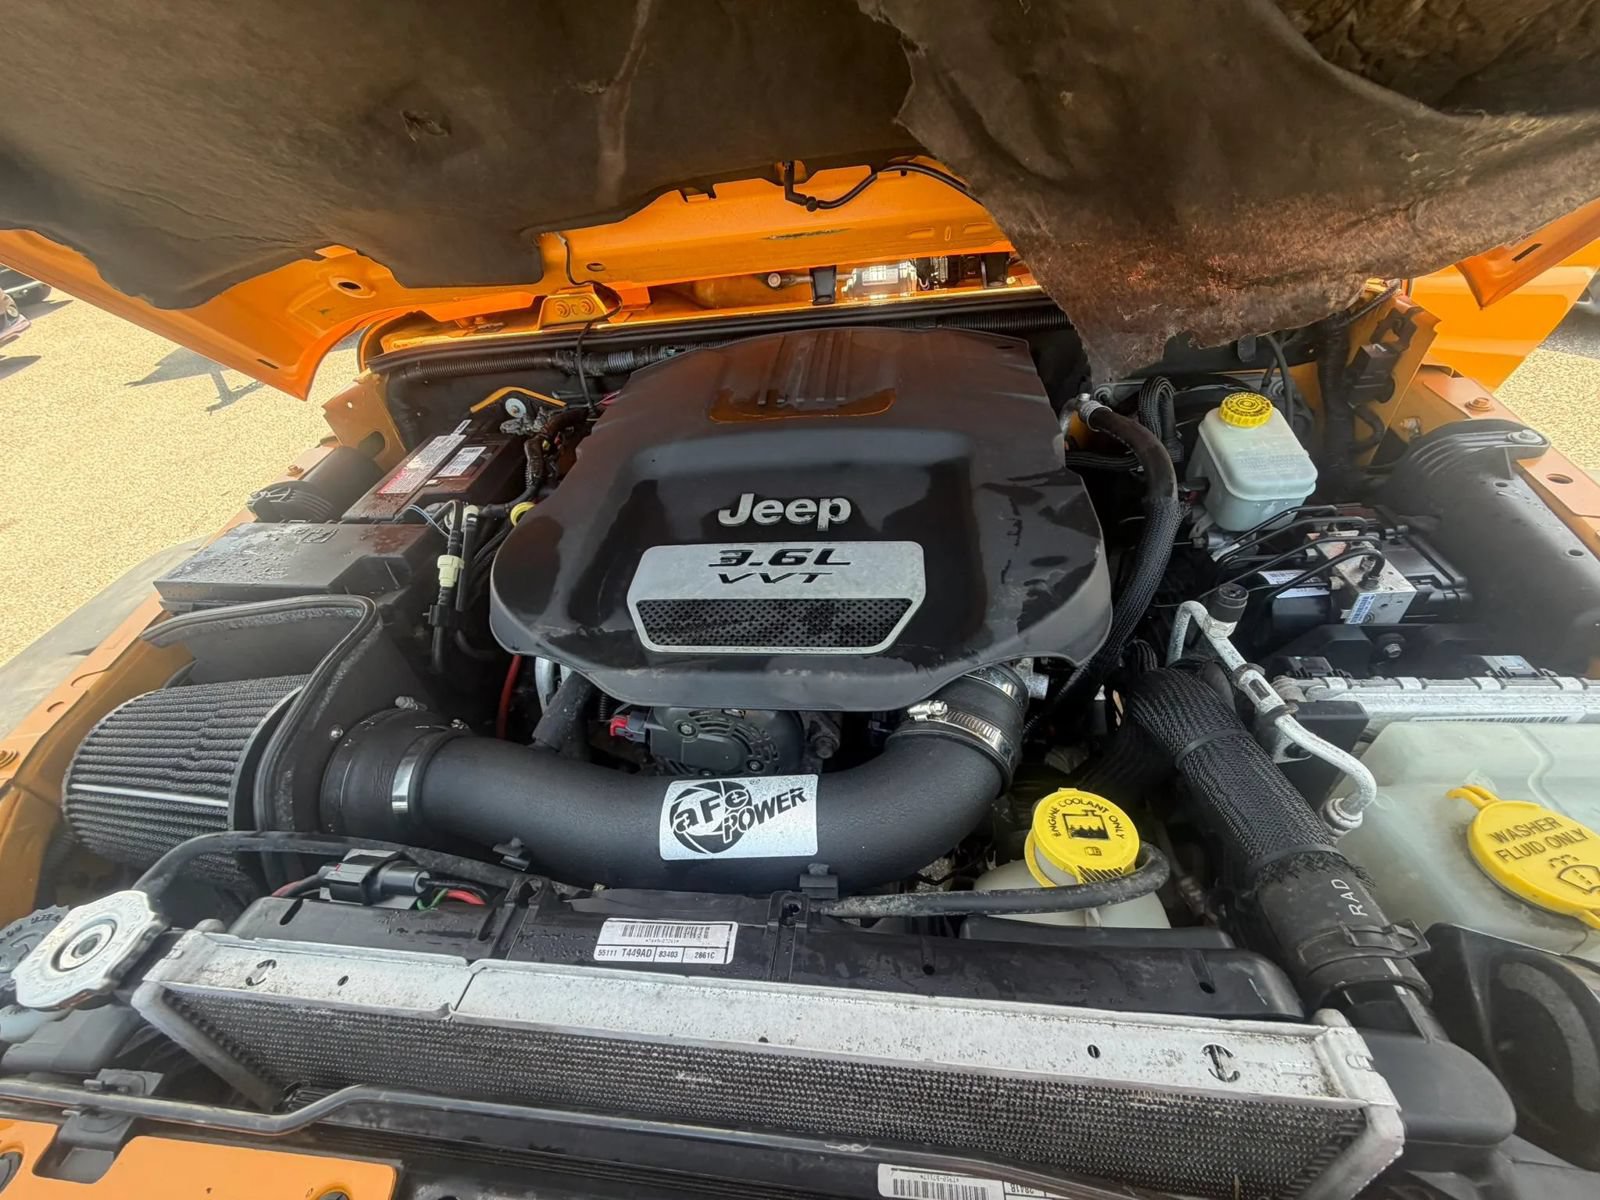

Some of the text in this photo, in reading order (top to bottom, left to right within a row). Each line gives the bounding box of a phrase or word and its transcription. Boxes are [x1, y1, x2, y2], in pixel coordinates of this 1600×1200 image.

[718, 493, 851, 531] Jeep
[708, 548, 851, 567] 3.6L
[718, 572, 833, 584] VVT
[674, 788, 750, 833] aFe
[723, 787, 807, 843] POWER
[1047, 797, 1125, 840] ENGINE COOLANT ONLY
[1488, 816, 1562, 844] WASHER
[1495, 828, 1590, 864] FLUID ONLY
[1331, 879, 1368, 916] RAD
[597, 947, 653, 958] 55111 T449AD
[658, 949, 679, 959] 83403
[694, 951, 716, 960] 2861C
